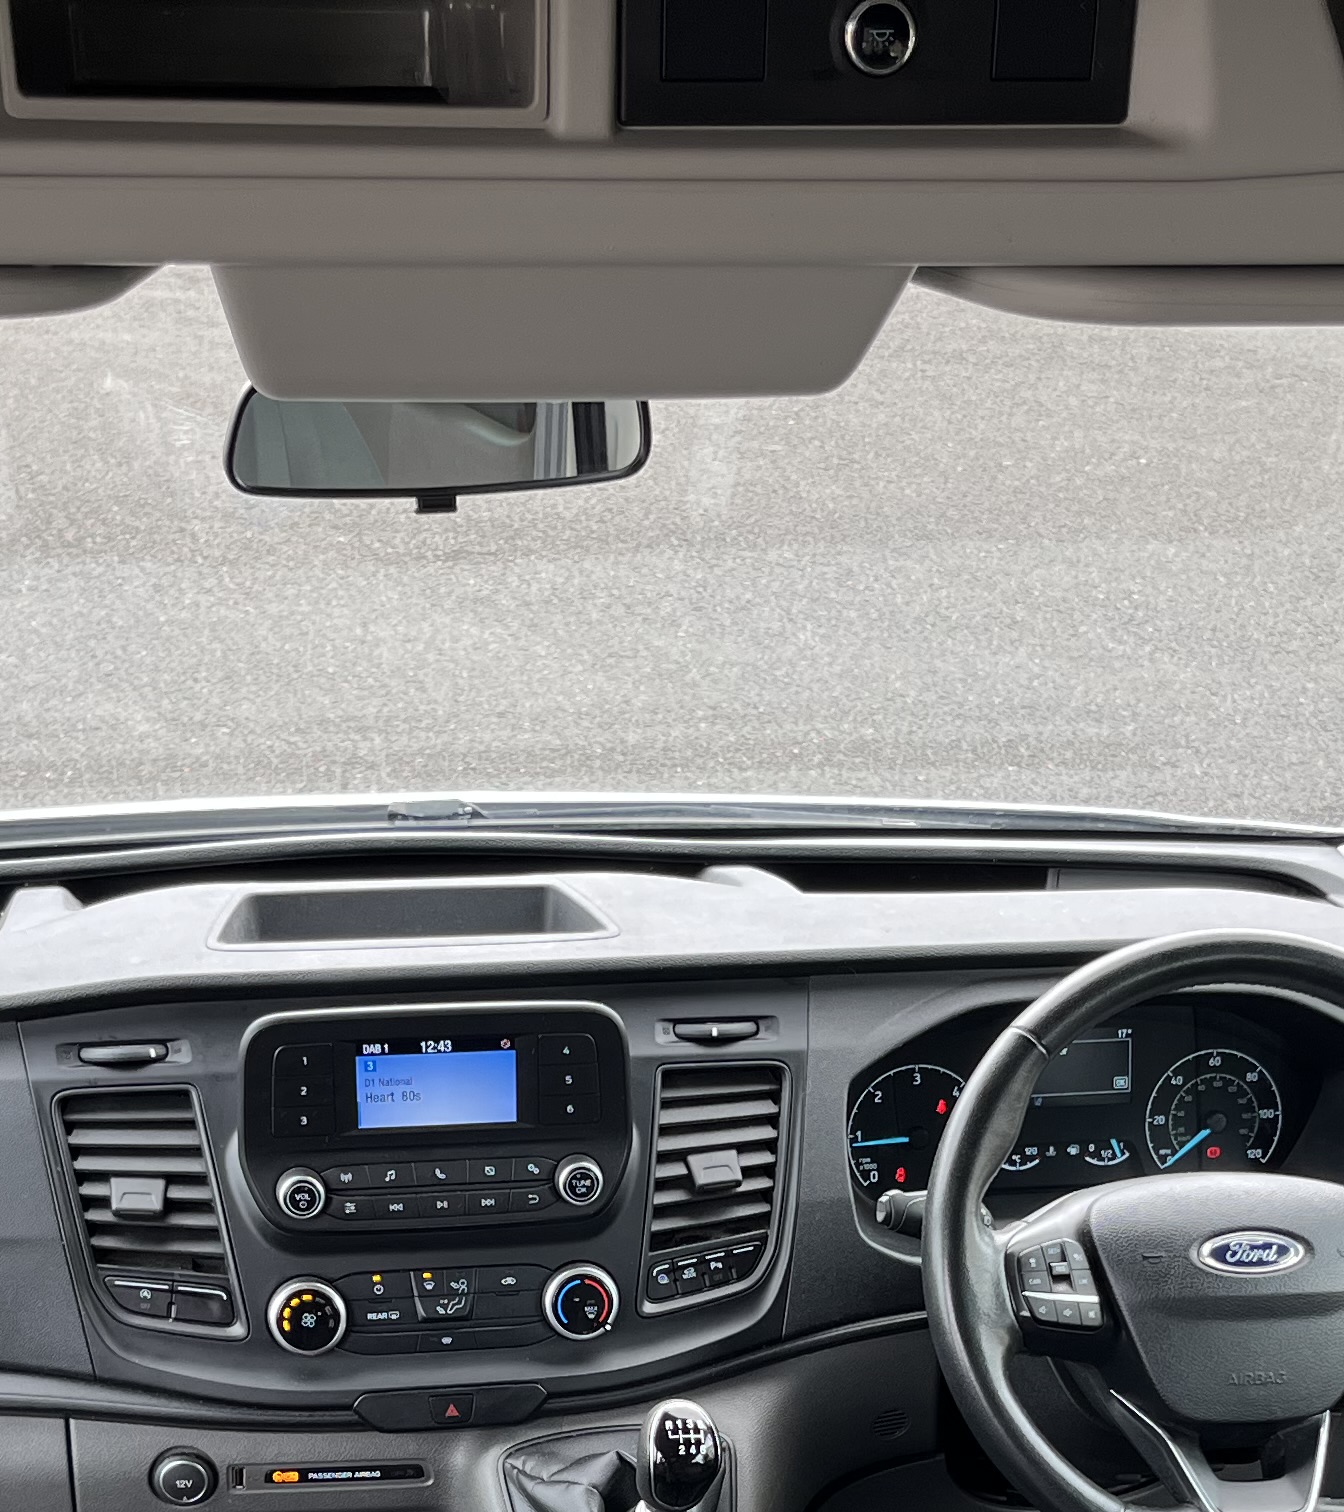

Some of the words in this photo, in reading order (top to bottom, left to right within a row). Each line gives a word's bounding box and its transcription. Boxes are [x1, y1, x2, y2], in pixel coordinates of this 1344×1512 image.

[362, 1044, 382, 1054] DAB
[383, 1043, 389, 1054] 1
[419, 1040, 453, 1053] 12:43
[562, 1046, 571, 1056] 4
[301, 1056, 309, 1066] 1
[366, 1061, 374, 1071] 3
[1208, 1056, 1222, 1067] 60
[564, 1075, 573, 1085] 5
[912, 1073, 922, 1085] 3
[1170, 1075, 1184, 1086] 40
[1246, 1072, 1259, 1082] 80
[364, 1078, 376, 1088] D1
[378, 1077, 413, 1087] National
[300, 1086, 308, 1096] 2
[952, 1085, 960, 1098] 4
[365, 1091, 396, 1104] Heart
[401, 1090, 422, 1102] 80s
[874, 1090, 883, 1103] 2
[566, 1105, 575, 1115] 6
[1258, 1109, 1275, 1119] 100
[300, 1116, 308, 1126] 3
[1153, 1115, 1166, 1125] 20
[855, 1130, 862, 1142] 1
[1246, 1149, 1263, 1159] 120
[869, 1171, 879, 1183] 0
[294, 1193, 311, 1201] VOL
[1225, 1240, 1278, 1263] Ford
[367, 1312, 388, 1320] REAR
[1227, 1371, 1287, 1386] AIRBAG
[676, 1419, 683, 1429] 1
[685, 1418, 694, 1429] 3
[678, 1445, 686, 1455] 2
[689, 1445, 697, 1455] 4
[308, 1471, 353, 1480] PASSENGER
[353, 1470, 381, 1479] AIRBAG
[175, 1479, 193, 1488] 12V
